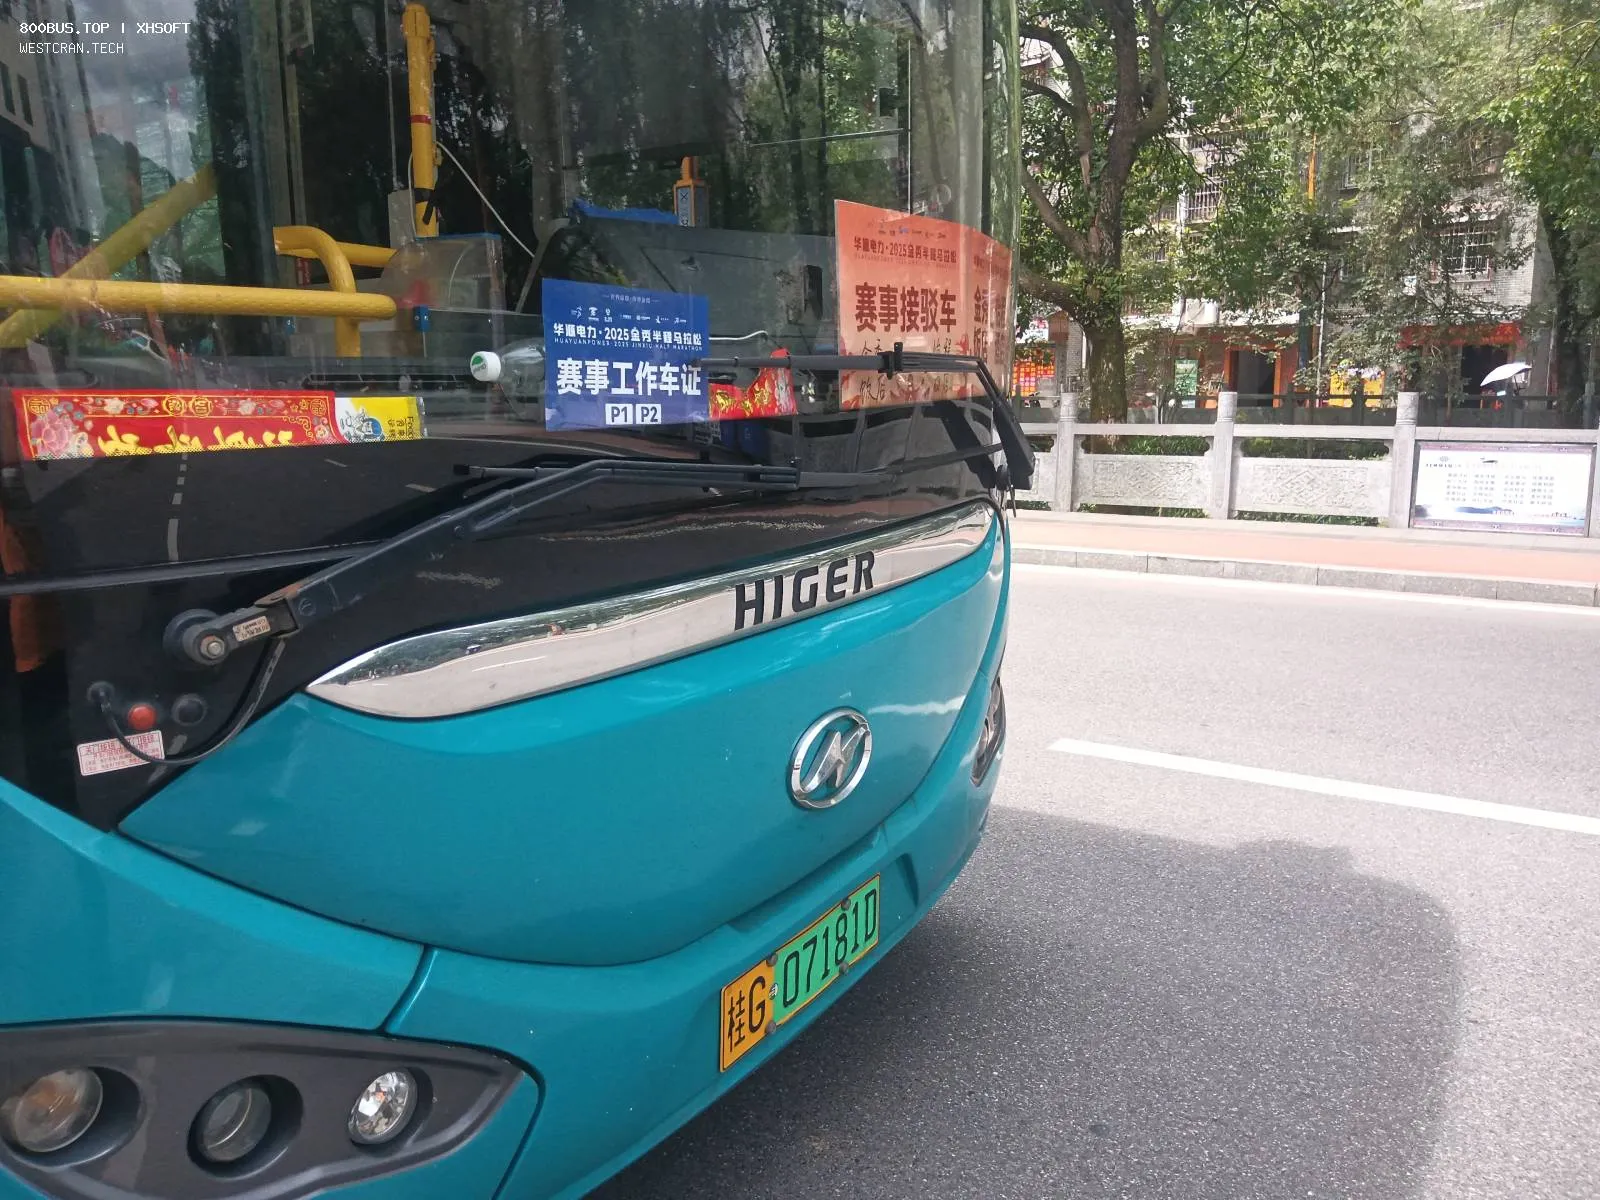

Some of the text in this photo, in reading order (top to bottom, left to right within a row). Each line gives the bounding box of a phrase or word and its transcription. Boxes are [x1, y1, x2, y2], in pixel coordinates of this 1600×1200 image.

[854, 282, 957, 333] 赛事接驳车
[556, 357, 702, 396] 赛事工作车证
[611, 406, 659, 423] P1 P2
[734, 551, 875, 631] HIGER
[782, 888, 877, 1009] 07181D
